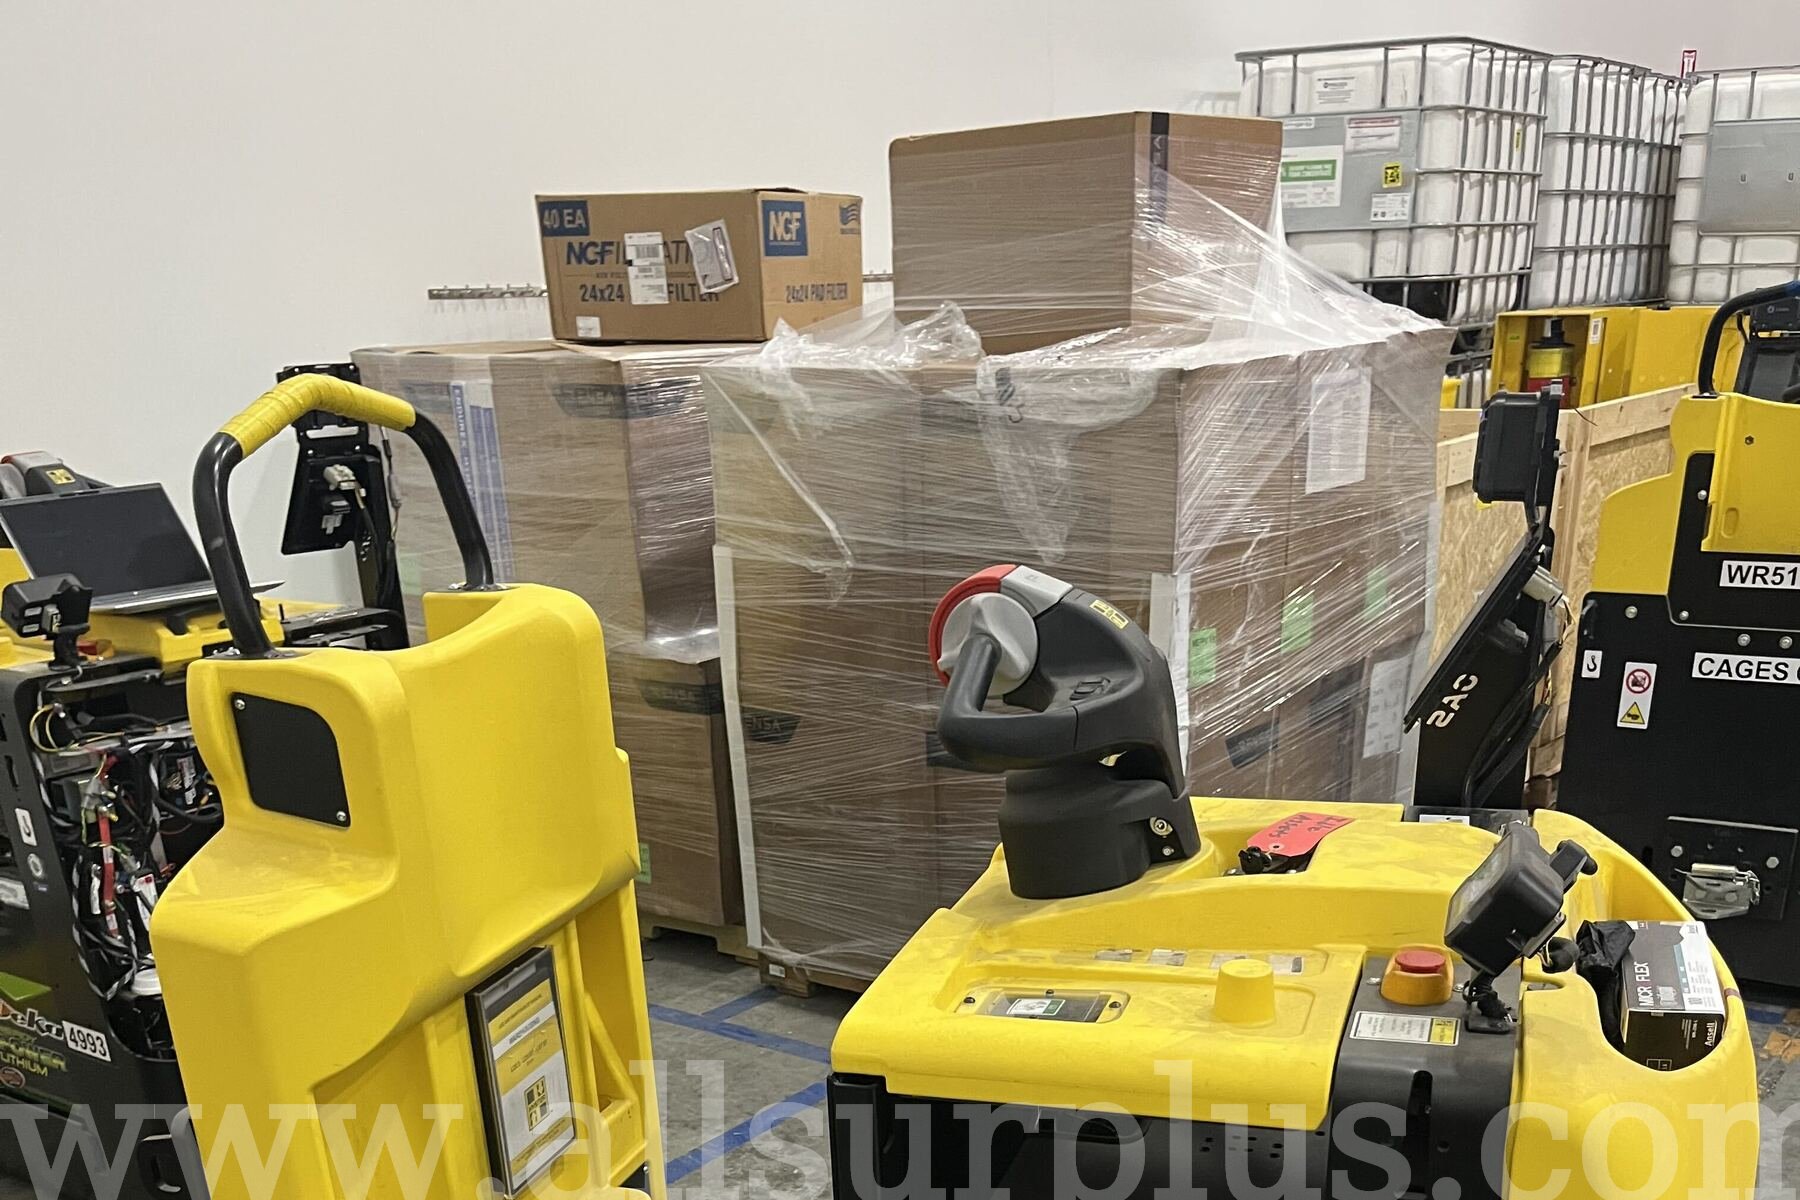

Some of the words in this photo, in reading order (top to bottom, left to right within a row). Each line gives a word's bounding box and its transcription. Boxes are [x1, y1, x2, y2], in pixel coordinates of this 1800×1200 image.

[543, 210, 559, 229] 40
[563, 209, 586, 228] EA
[769, 211, 801, 240] NCF
[1698, 657, 1789, 681] CAGES
[69, 1026, 107, 1057] 4993
[1704, 1022, 1716, 1047] Ansell
